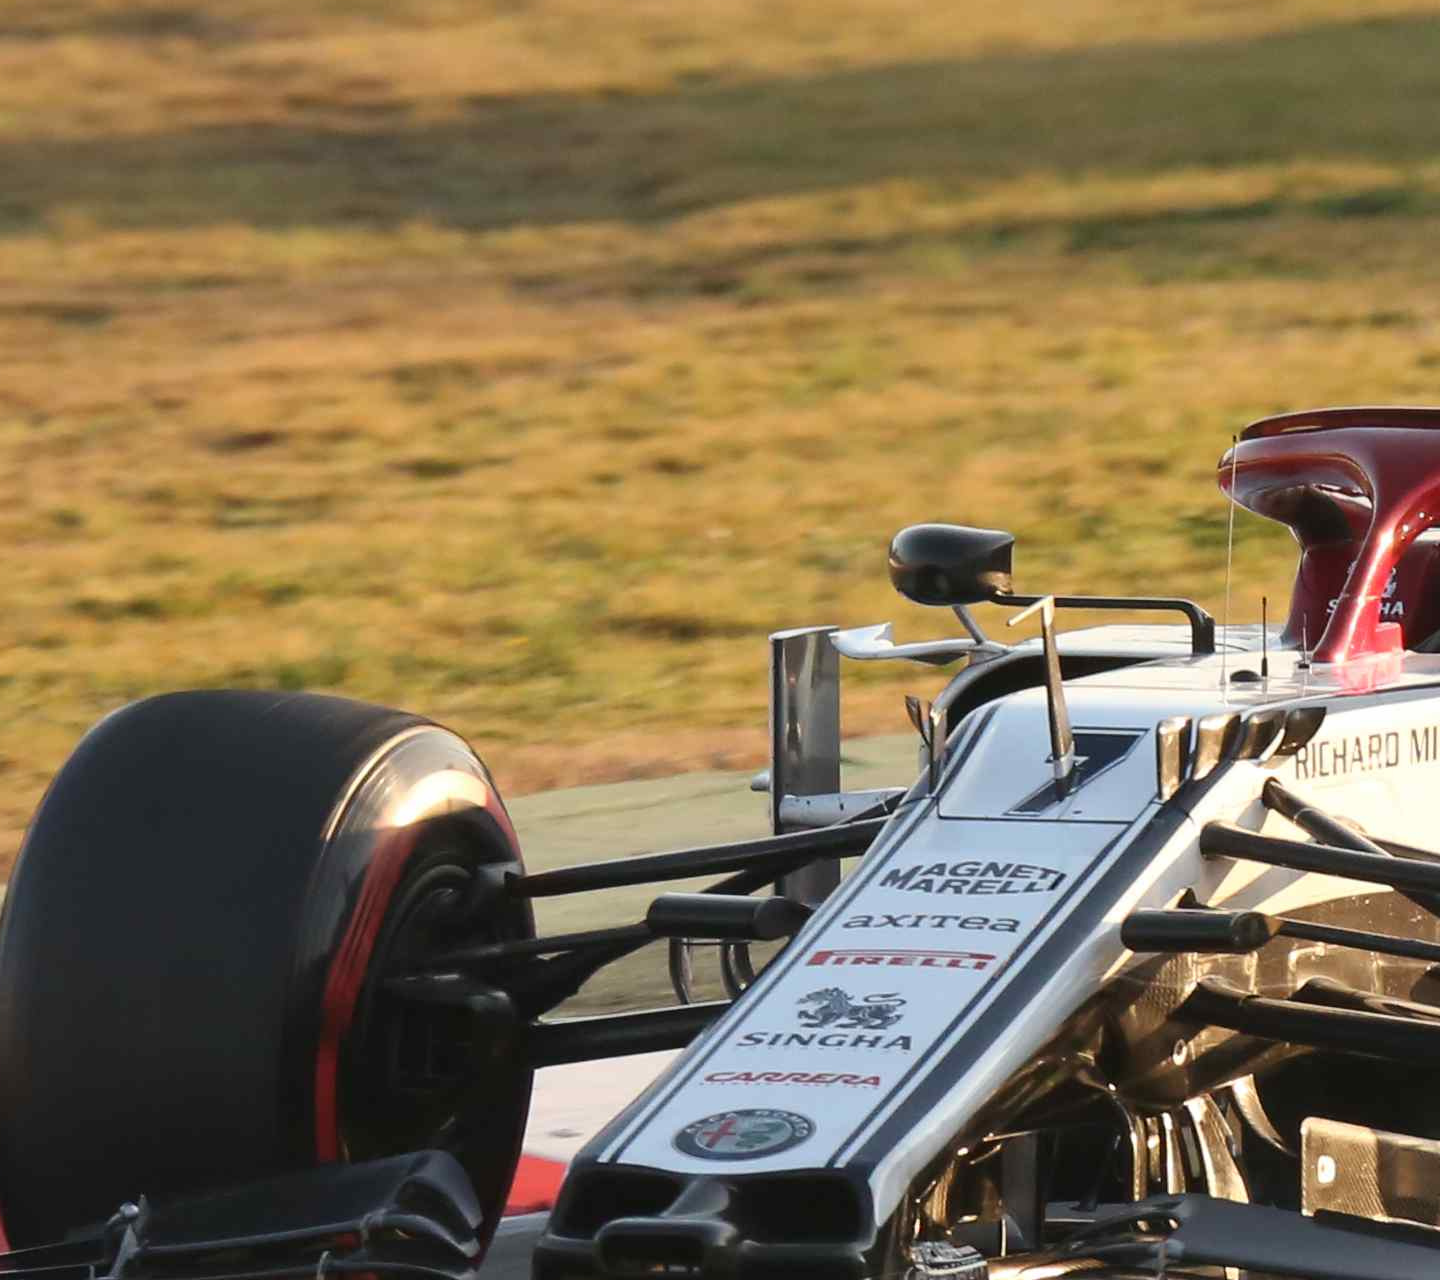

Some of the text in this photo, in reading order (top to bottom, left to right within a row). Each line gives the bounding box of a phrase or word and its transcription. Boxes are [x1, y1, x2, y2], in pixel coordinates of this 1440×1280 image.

[1295, 731, 1400, 780] RICHARD
[805, 949, 997, 970] PIRELLI
[736, 1031, 912, 1051] SINGHA
[704, 1071, 880, 1086] CARRERA
